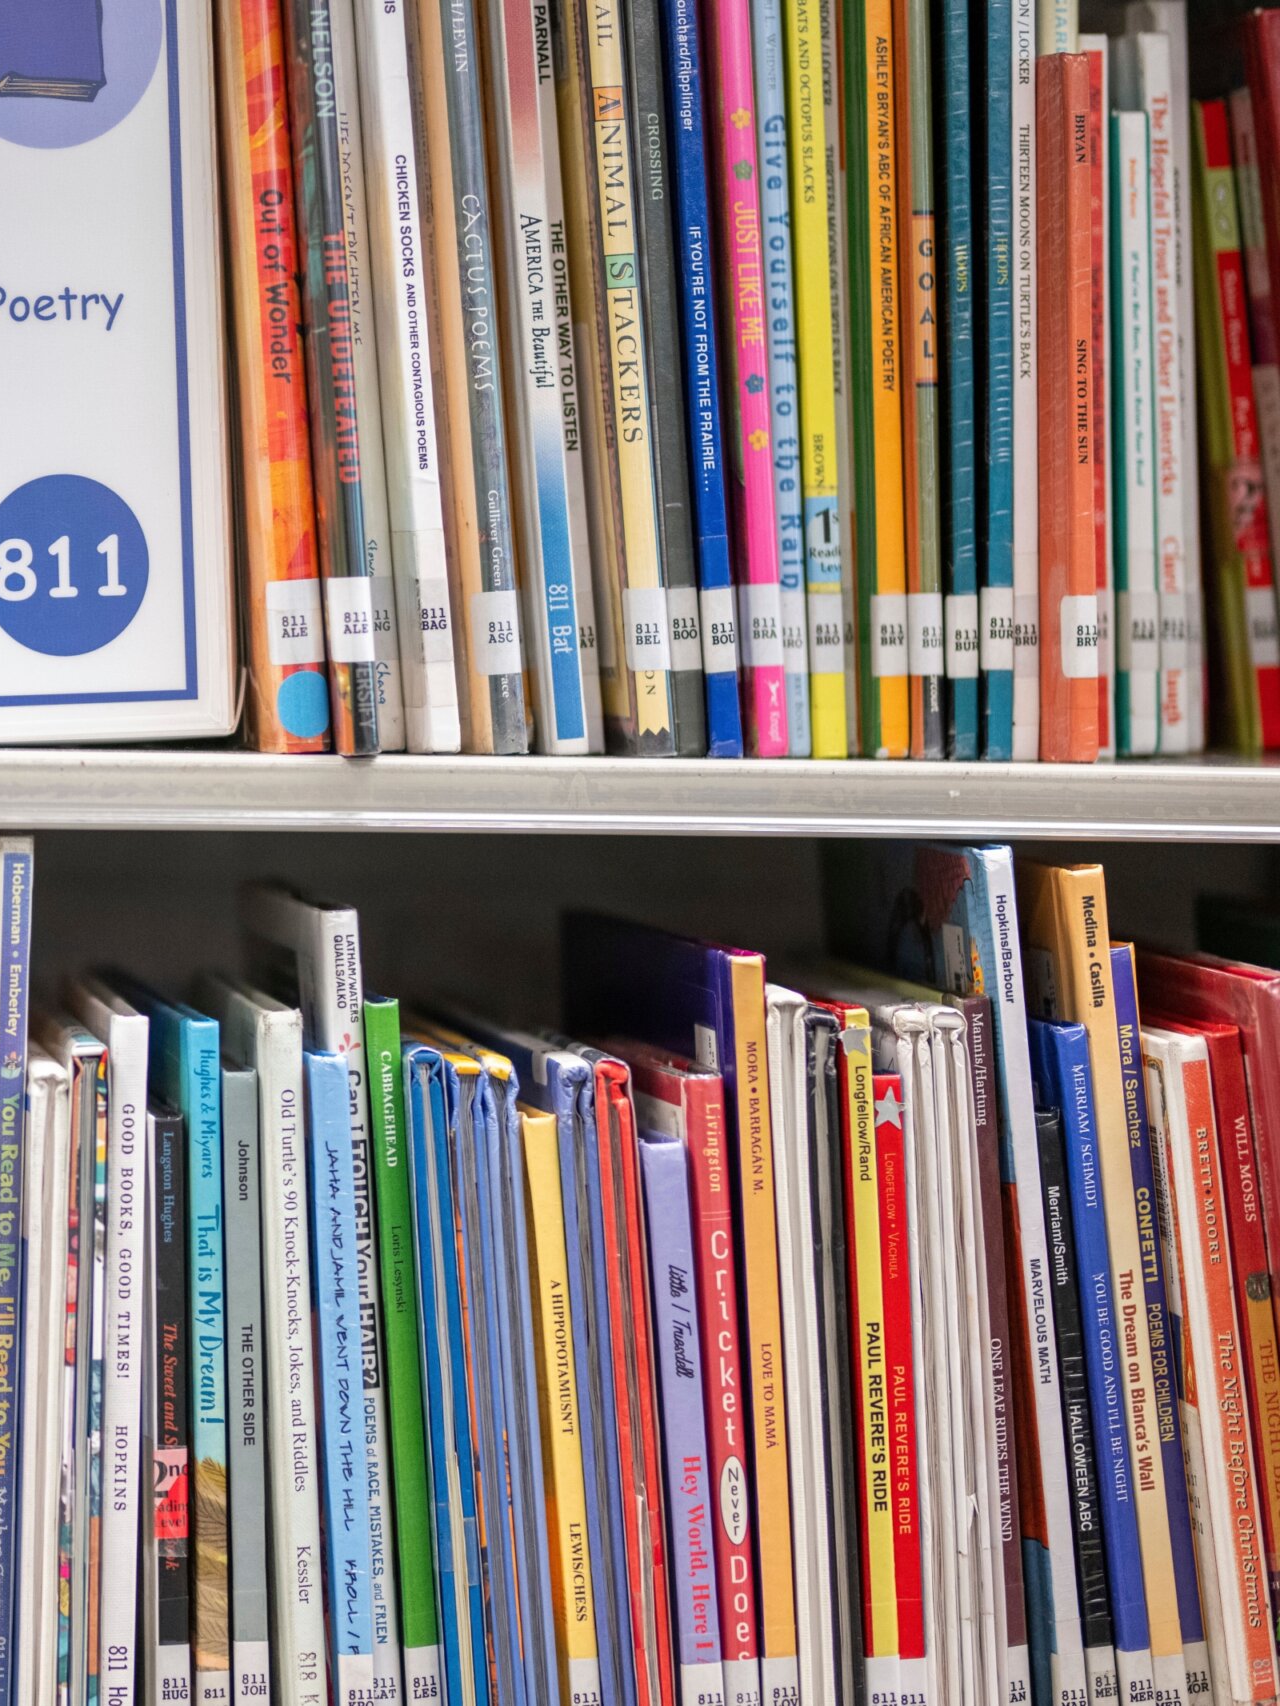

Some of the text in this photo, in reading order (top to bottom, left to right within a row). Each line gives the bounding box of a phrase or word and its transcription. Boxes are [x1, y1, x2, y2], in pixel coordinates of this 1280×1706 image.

[311, 10, 335, 118] NELSON
[535, 5, 552, 85] PARNALL
[1075, 115, 1086, 163] BRYAN
[260, 189, 291, 384] Out of Wonder
[395, 155, 428, 470] CHICKEN SOCKS AND OTHER CONTAGIOUS POEMS
[520, 213, 556, 389] AMERICA THE Beautiful
[597, 93, 644, 443] ANIMAL STACKERS
[1077, 339, 1088, 464] SING TO THE SUN
[548, 584, 573, 654] 811 Bat
[636, 623, 659, 634] 811
[636, 633, 660, 645] BEL
[5, 863, 24, 1036] Hoberman Emberley
[996, 894, 1015, 1003] Hopkins/Barbour
[1082, 896, 1103, 1008] Medina Casilla
[1, 1096, 21, 1136] You
[380, 1051, 398, 1168] CABBAGEHEAD
[854, 1065, 871, 1181] Longfellow/Rand
[972, 1013, 987, 1126] Mannis/Hartung
[0, 1143, 18, 1203] Read
[0, 1211, 16, 1237] to
[238, 1140, 248, 1201] Johnson
[117, 1104, 135, 1379] GOOD BOOKS, GOOD TIMES!
[280, 1088, 306, 1492] Old Turtle's 90 Knock-Knocks, Jokes, and Riddles
[1047, 1185, 1067, 1287] Merriam/Smith
[196, 1205, 224, 1425] That is My Dream!
[550, 1280, 574, 1435] A HIPPOPOTAMUSN'T
[1029, 1258, 1051, 1384] MARVELOUS MATH
[242, 1325, 255, 1446] THE OTHER SIDE
[866, 1322, 888, 1512] PAUL REVERE'S RIDE
[1119, 1270, 1156, 1491] The Dream on Blanca's Wall
[114, 1425, 127, 1512] HOPKINS
[1069, 1405, 1093, 1531] HALLOWEEN ABC
[1217, 1332, 1262, 1628] The Night Before Christmas
[296, 1545, 310, 1604] Kessler
[569, 1523, 588, 1622] LEWIS/CHESS
[242, 1674, 266, 1685] 811
[242, 1685, 267, 1696] JOH
